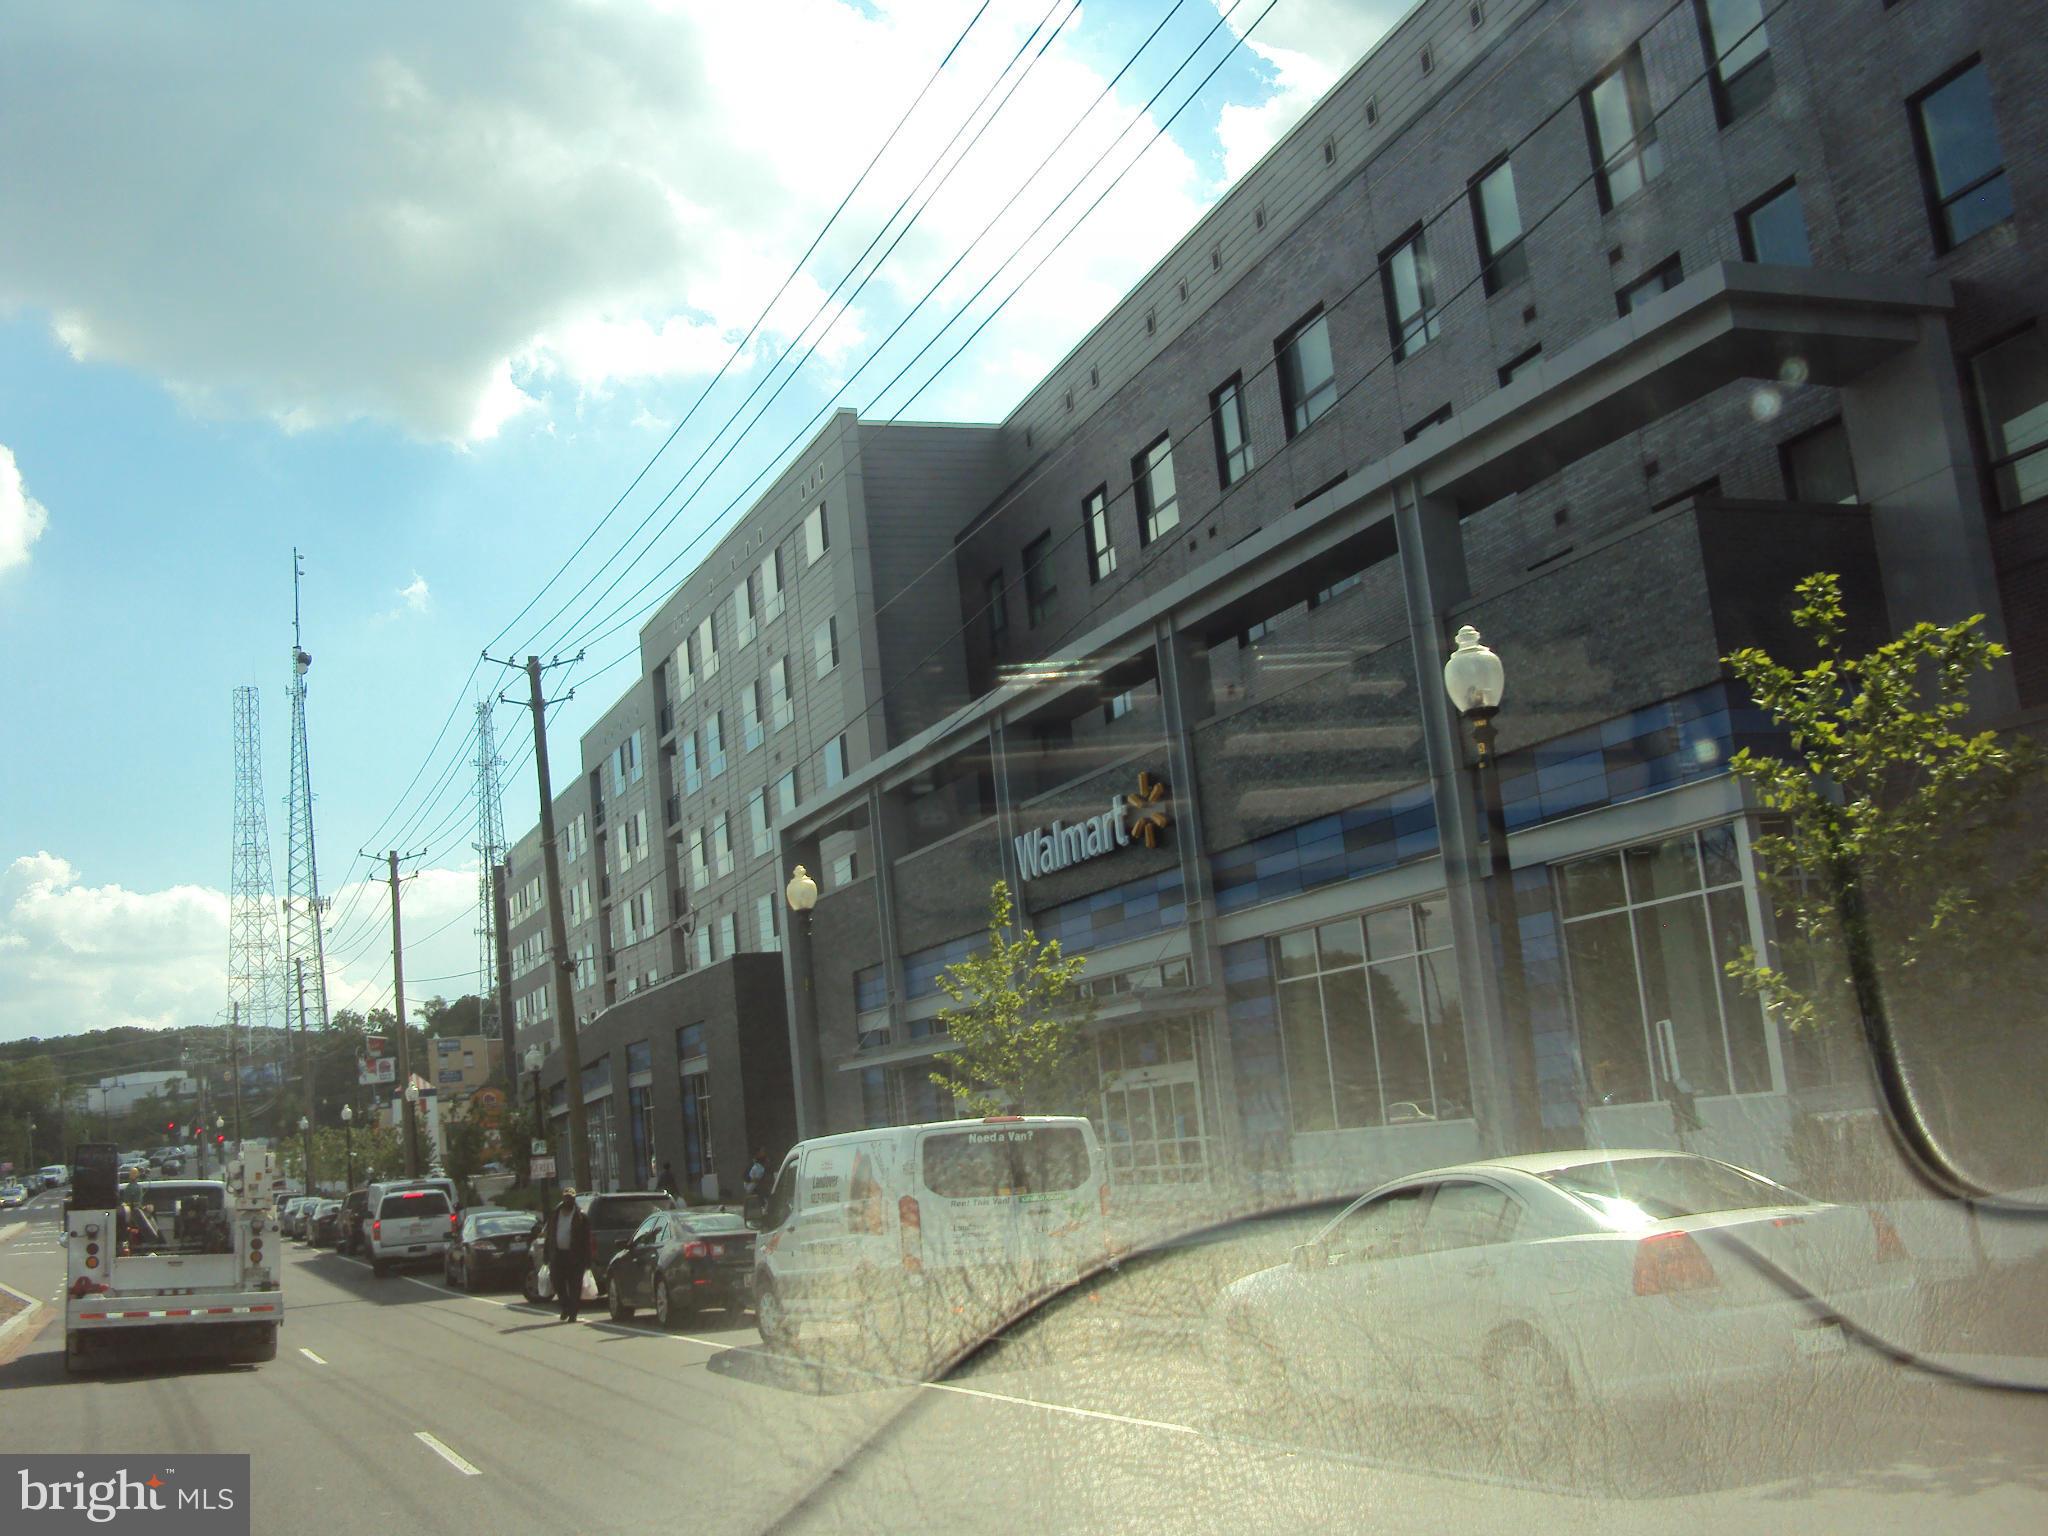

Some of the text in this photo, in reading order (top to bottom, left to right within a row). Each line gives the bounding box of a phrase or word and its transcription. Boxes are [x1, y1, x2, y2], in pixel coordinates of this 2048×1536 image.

[1015, 794, 1129, 881] Walmart
[968, 1130, 1033, 1145] Need a Van?
